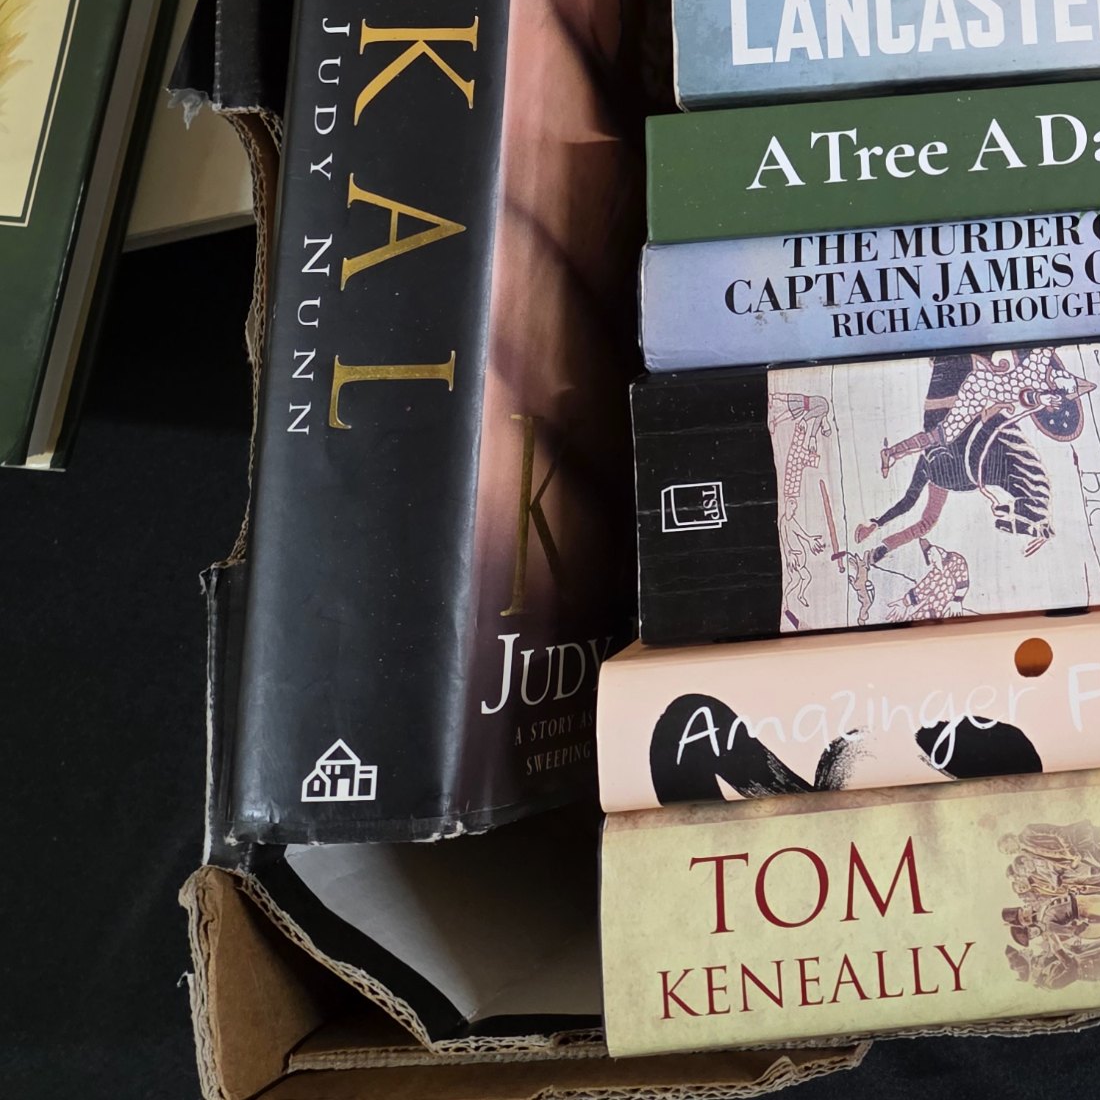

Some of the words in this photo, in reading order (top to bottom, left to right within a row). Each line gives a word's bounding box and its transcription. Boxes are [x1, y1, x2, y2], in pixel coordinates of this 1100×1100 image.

[309, 18, 351, 181] JUDY
[746, 136, 806, 191] A
[811, 128, 949, 184] Tree
[968, 118, 1027, 172] A
[329, 16, 479, 430] KAL
[783, 230, 879, 269] THE
[890, 213, 1083, 260] MURDER
[724, 264, 921, 316] CAPTAIN
[932, 253, 1074, 302] JAMES
[832, 300, 981, 338] RICHARD
[286, 234, 333, 435] NUNN
[526, 739, 592, 776] SWEEPING
[530, 711, 575, 741] STORY
[677, 682, 1036, 770] Amazinger
[689, 836, 933, 936] TOM
[659, 942, 975, 1020] KENEALLY
